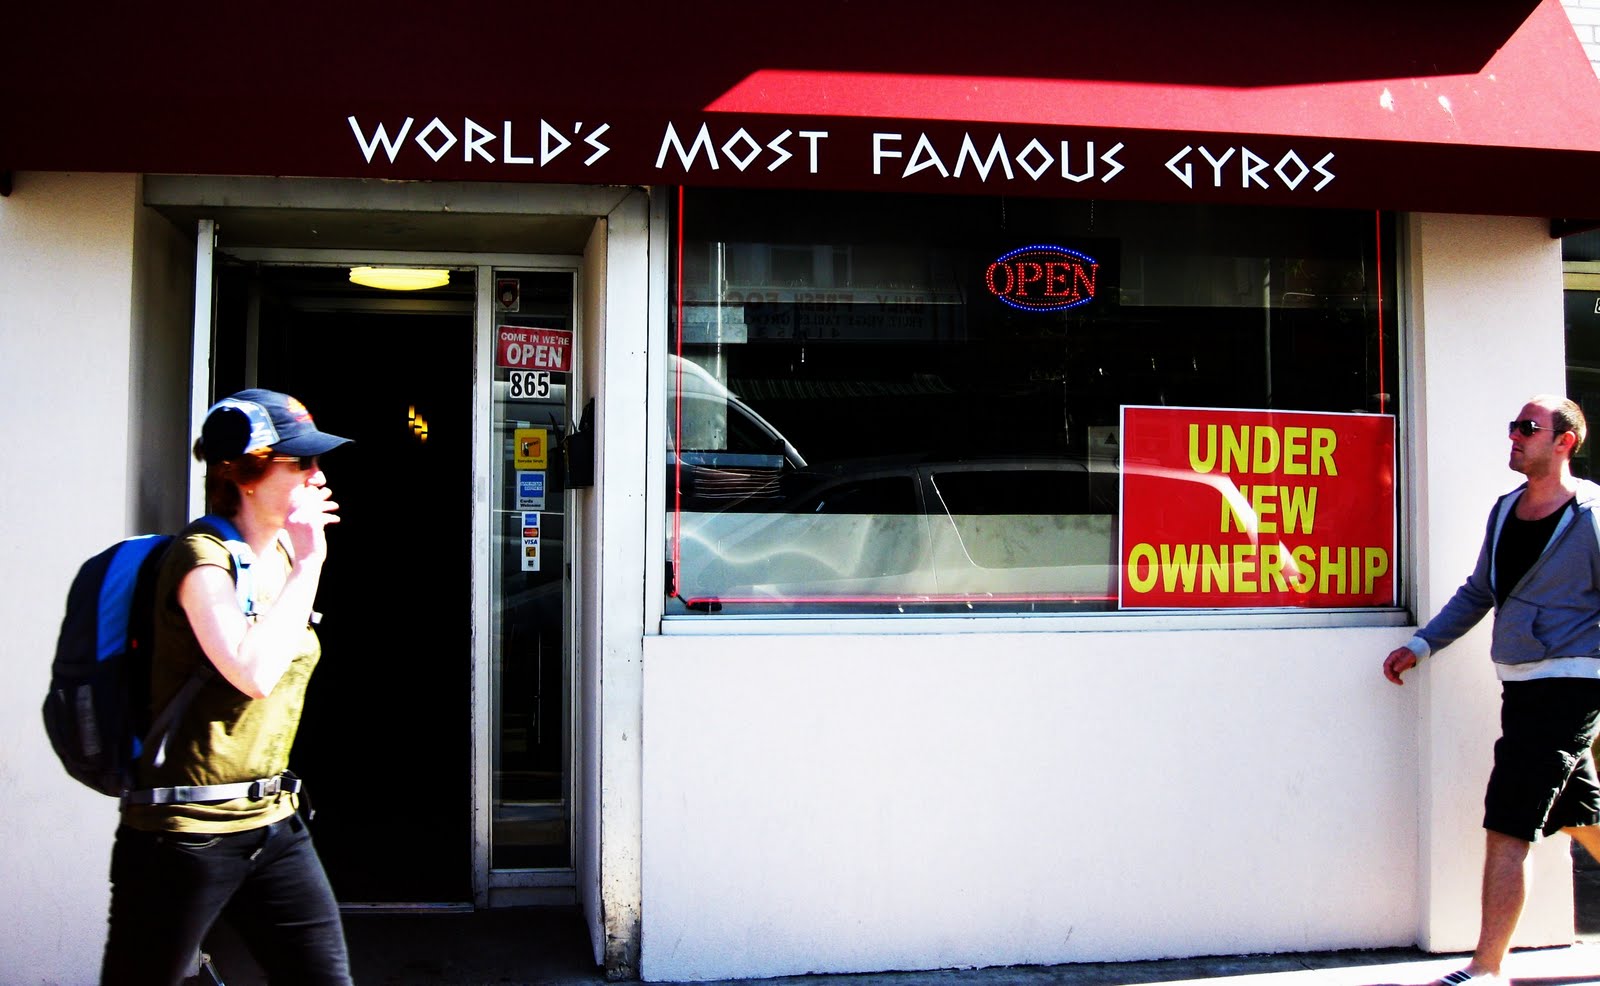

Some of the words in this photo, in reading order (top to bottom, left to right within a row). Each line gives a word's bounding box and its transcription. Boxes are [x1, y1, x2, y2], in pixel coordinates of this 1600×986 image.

[347, 115, 611, 167] WORLD'S
[655, 120, 829, 174] MOST
[872, 132, 1125, 184] FAMOUS
[1164, 145, 1336, 193] GYROS
[985, 261, 1100, 298] OPEN
[500, 332, 527, 343] COME
[529, 334, 539, 344] IN
[542, 336, 570, 346] WE'RE
[506, 343, 563, 368] OPEN
[510, 372, 550, 397] 865
[1188, 423, 1338, 476] UNDER
[1220, 484, 1318, 535] NEW
[1127, 542, 1389, 594] OWNERSHIP
